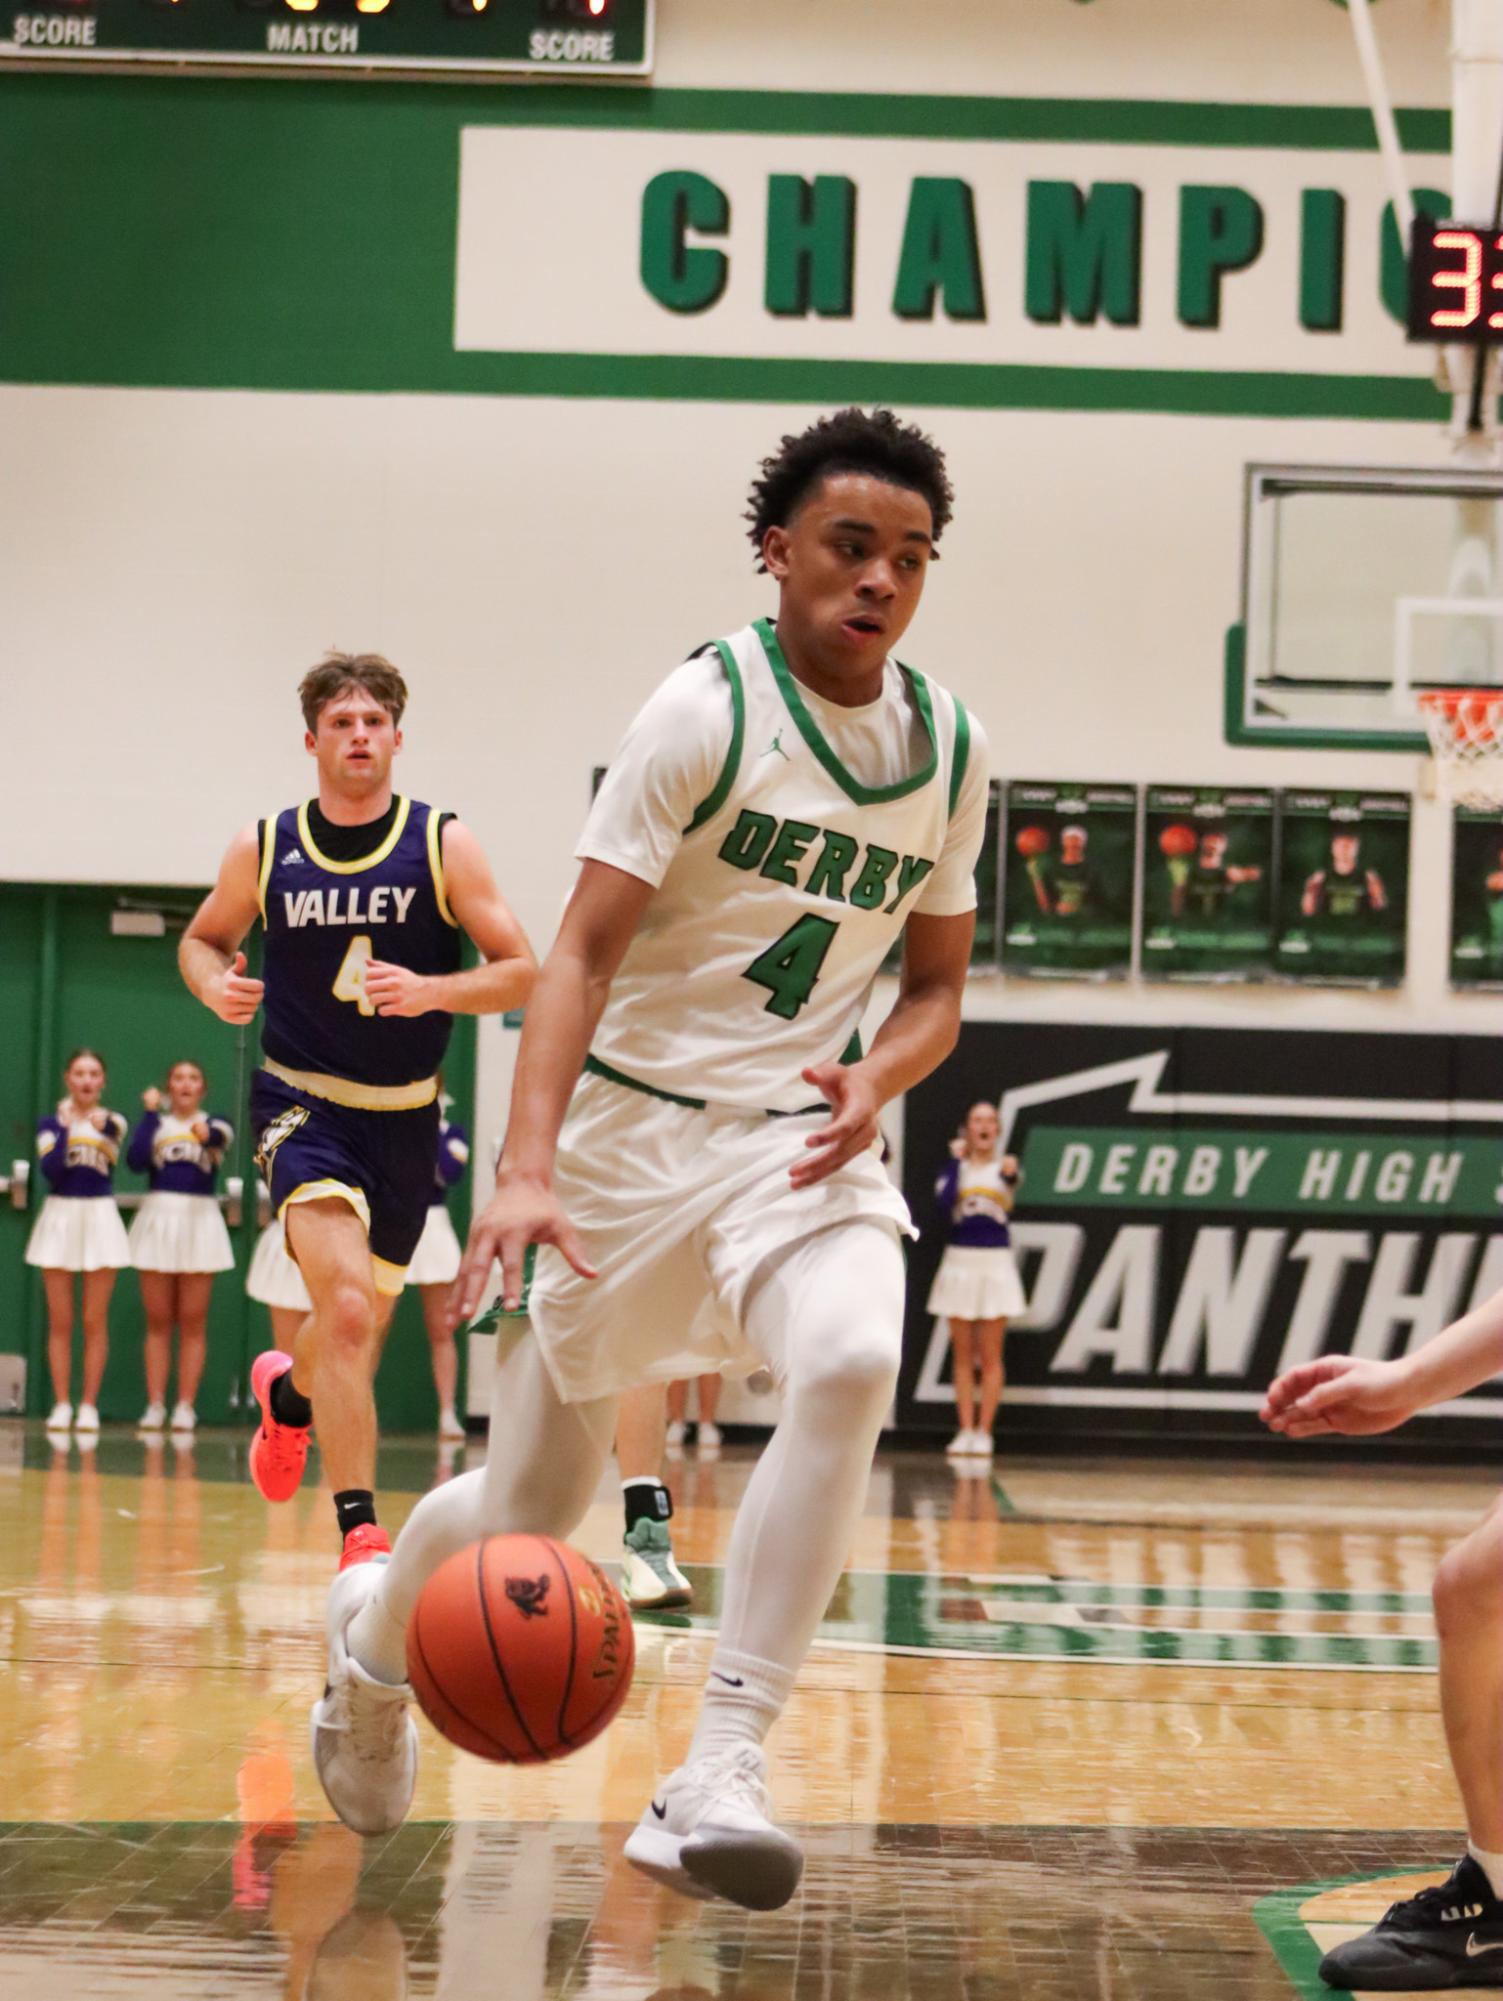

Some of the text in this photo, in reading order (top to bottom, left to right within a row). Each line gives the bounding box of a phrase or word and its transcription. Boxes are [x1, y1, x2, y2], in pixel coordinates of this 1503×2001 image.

[13, 17, 96, 46] SCORE
[267, 23, 358, 53] MATCH
[529, 32, 614, 62] SCORE
[718, 808, 935, 915] DERBY
[283, 886, 416, 928] VALLEY
[331, 934, 376, 1016] 4
[743, 911, 841, 1021] 4
[1054, 1143, 1270, 1197] DERBY
[1299, 1150, 1462, 1204] HIGH
